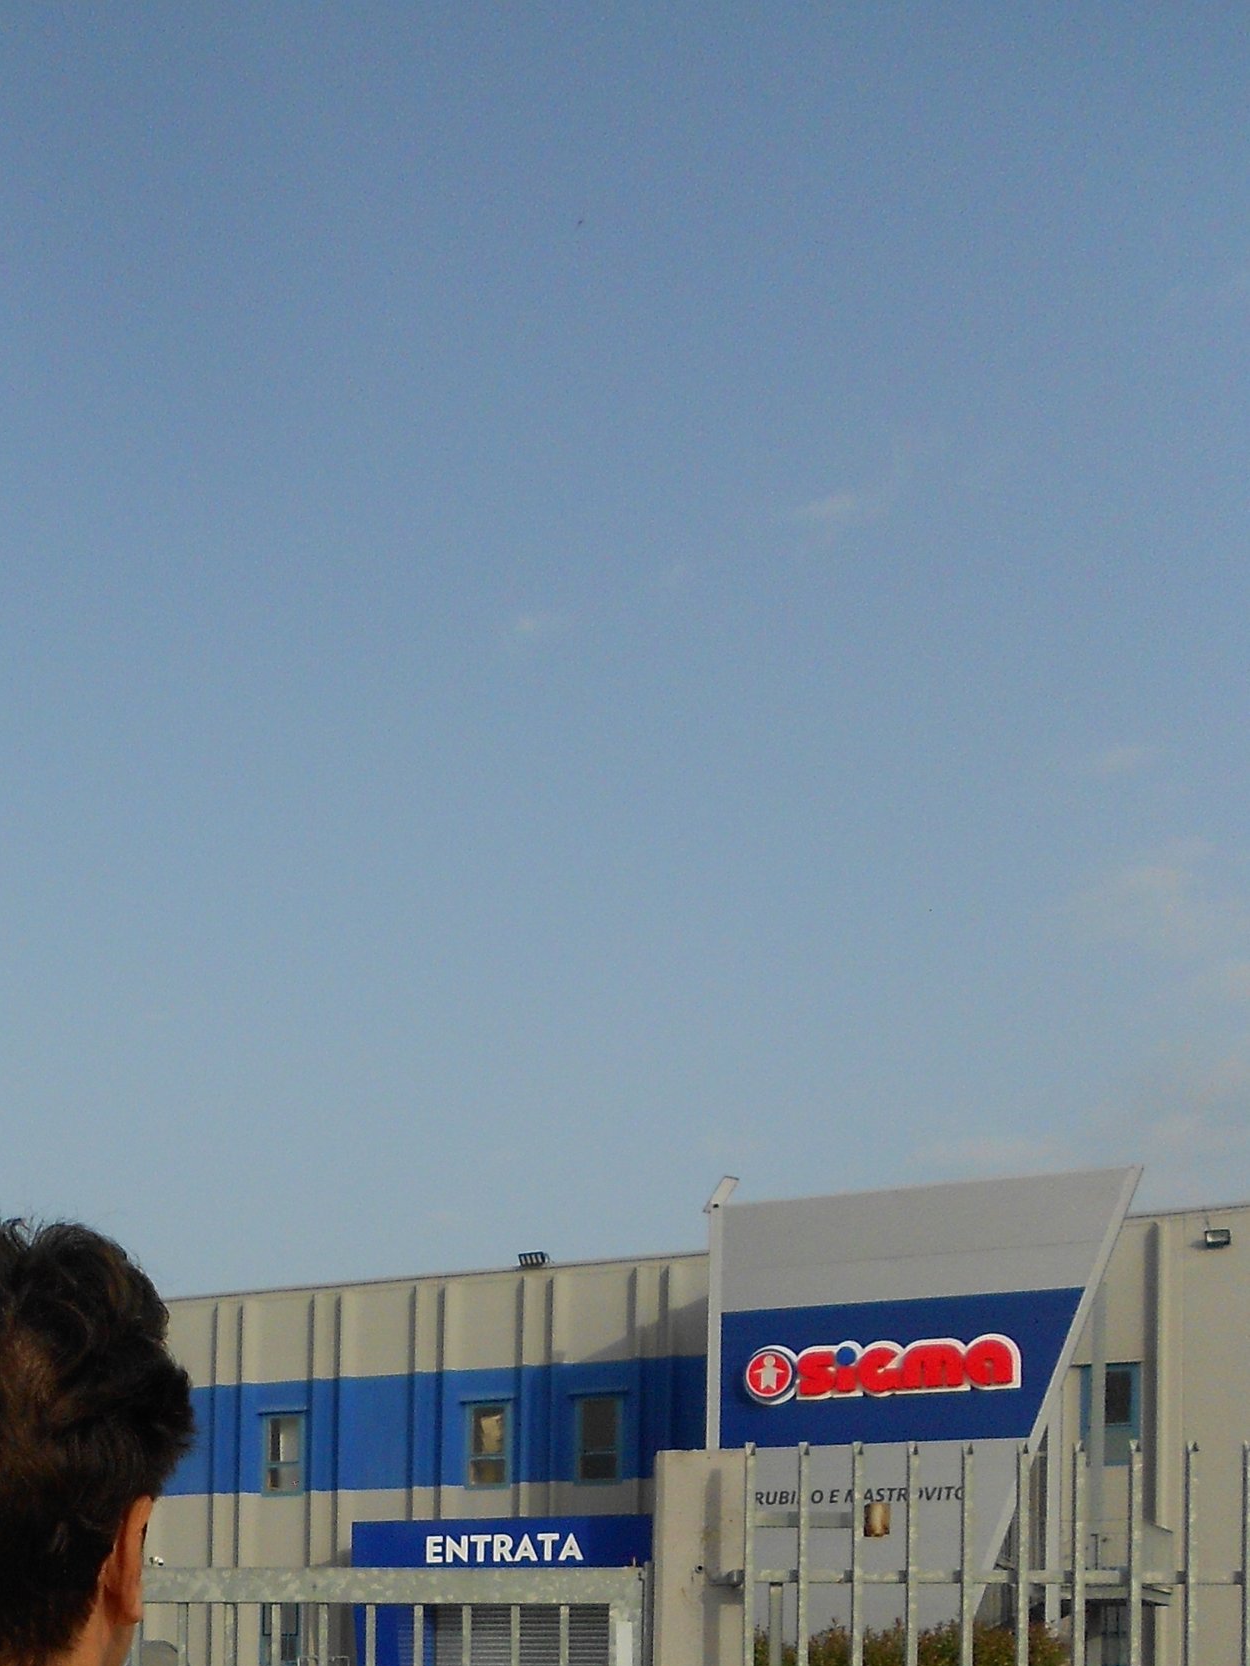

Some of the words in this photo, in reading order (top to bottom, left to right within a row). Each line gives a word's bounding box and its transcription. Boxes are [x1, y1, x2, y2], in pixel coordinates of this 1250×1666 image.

[755, 1490, 824, 1506] RUBIO
[829, 1489, 840, 1504] E
[425, 1532, 584, 1563] ENTRATA
